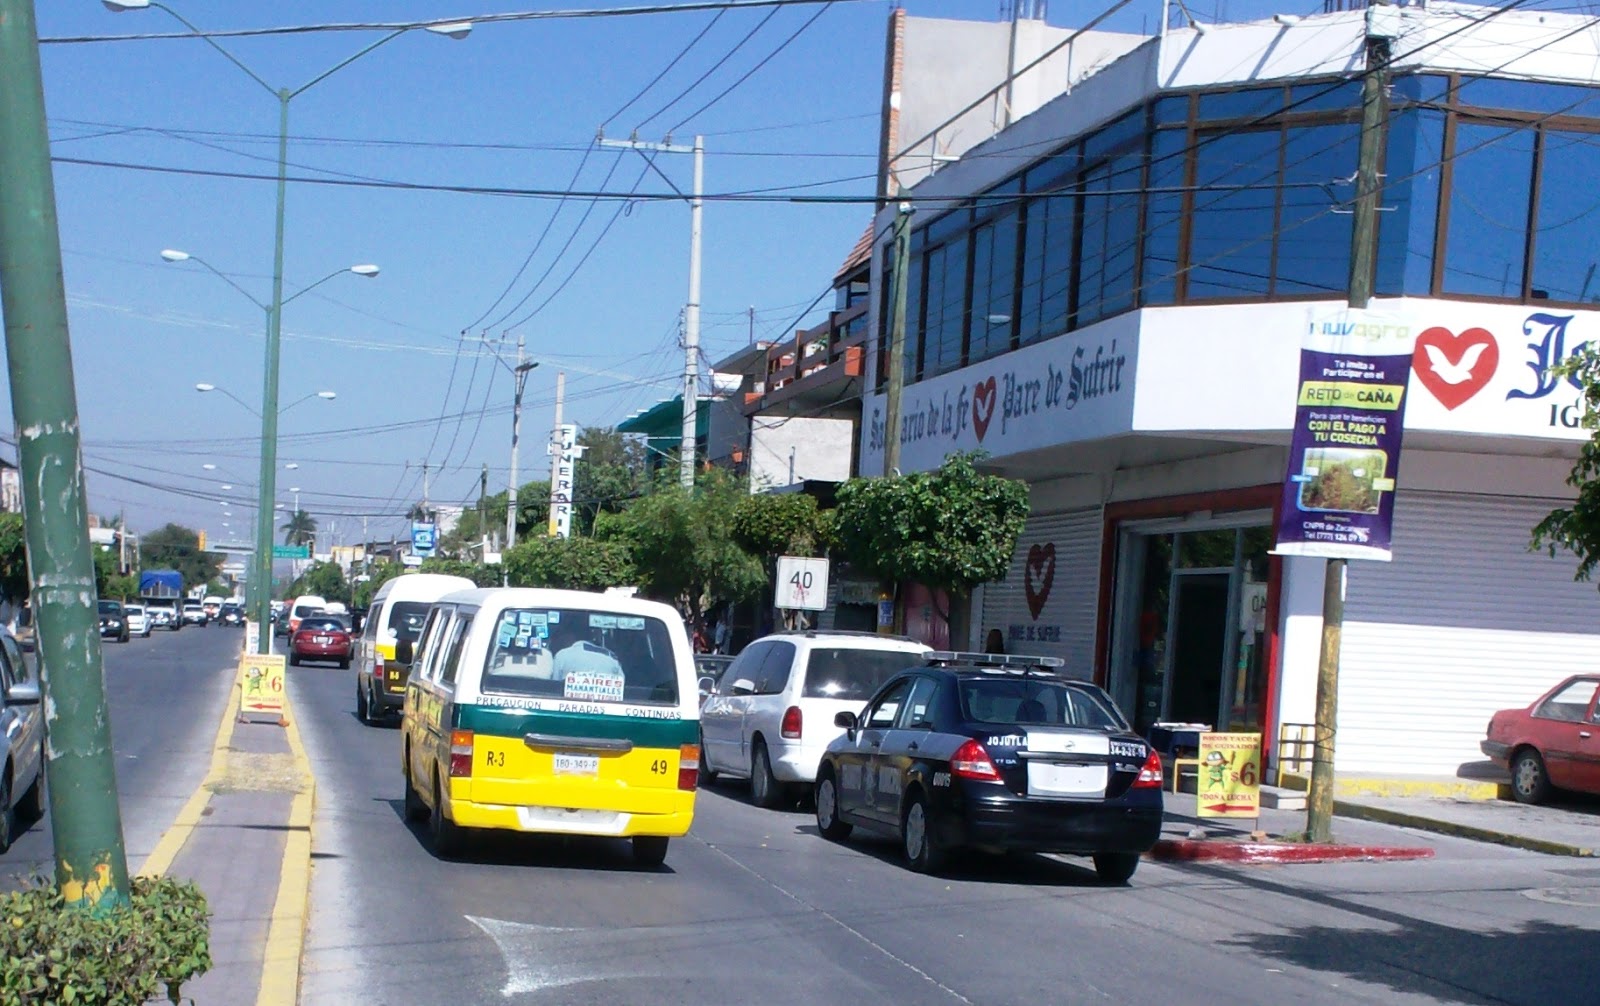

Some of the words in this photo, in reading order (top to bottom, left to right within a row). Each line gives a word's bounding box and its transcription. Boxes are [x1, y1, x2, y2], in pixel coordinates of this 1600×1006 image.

[1334, 360, 1345, 369] Te
[1323, 368, 1362, 379] Participar
[926, 400, 939, 438] de
[941, 389, 952, 435] la
[952, 384, 969, 439] fe
[1001, 371, 1041, 435] Pare
[1046, 363, 1063, 407] de
[1066, 339, 1125, 410] Sufrir
[1306, 388, 1341, 401] RETO
[1357, 388, 1394, 404] CAÑA
[1309, 411, 1327, 420] Para
[1308, 421, 1331, 431] CON
[1333, 421, 1347, 432] EL
[1348, 422, 1376, 434] PAGO
[1377, 425, 1386, 435] A
[1314, 432, 1329, 442] TU
[1330, 433, 1378, 446] COSECHA
[790, 571, 813, 589] 40
[567, 684, 621, 695] MANANTIALES
[476, 697, 541, 710] PRECAUCION
[558, 703, 605, 715] PARADAS
[625, 707, 682, 720] CONTINUAS
[987, 734, 1028, 747] JOJUTLA
[487, 751, 504, 768] R-3
[651, 759, 668, 775] 49
